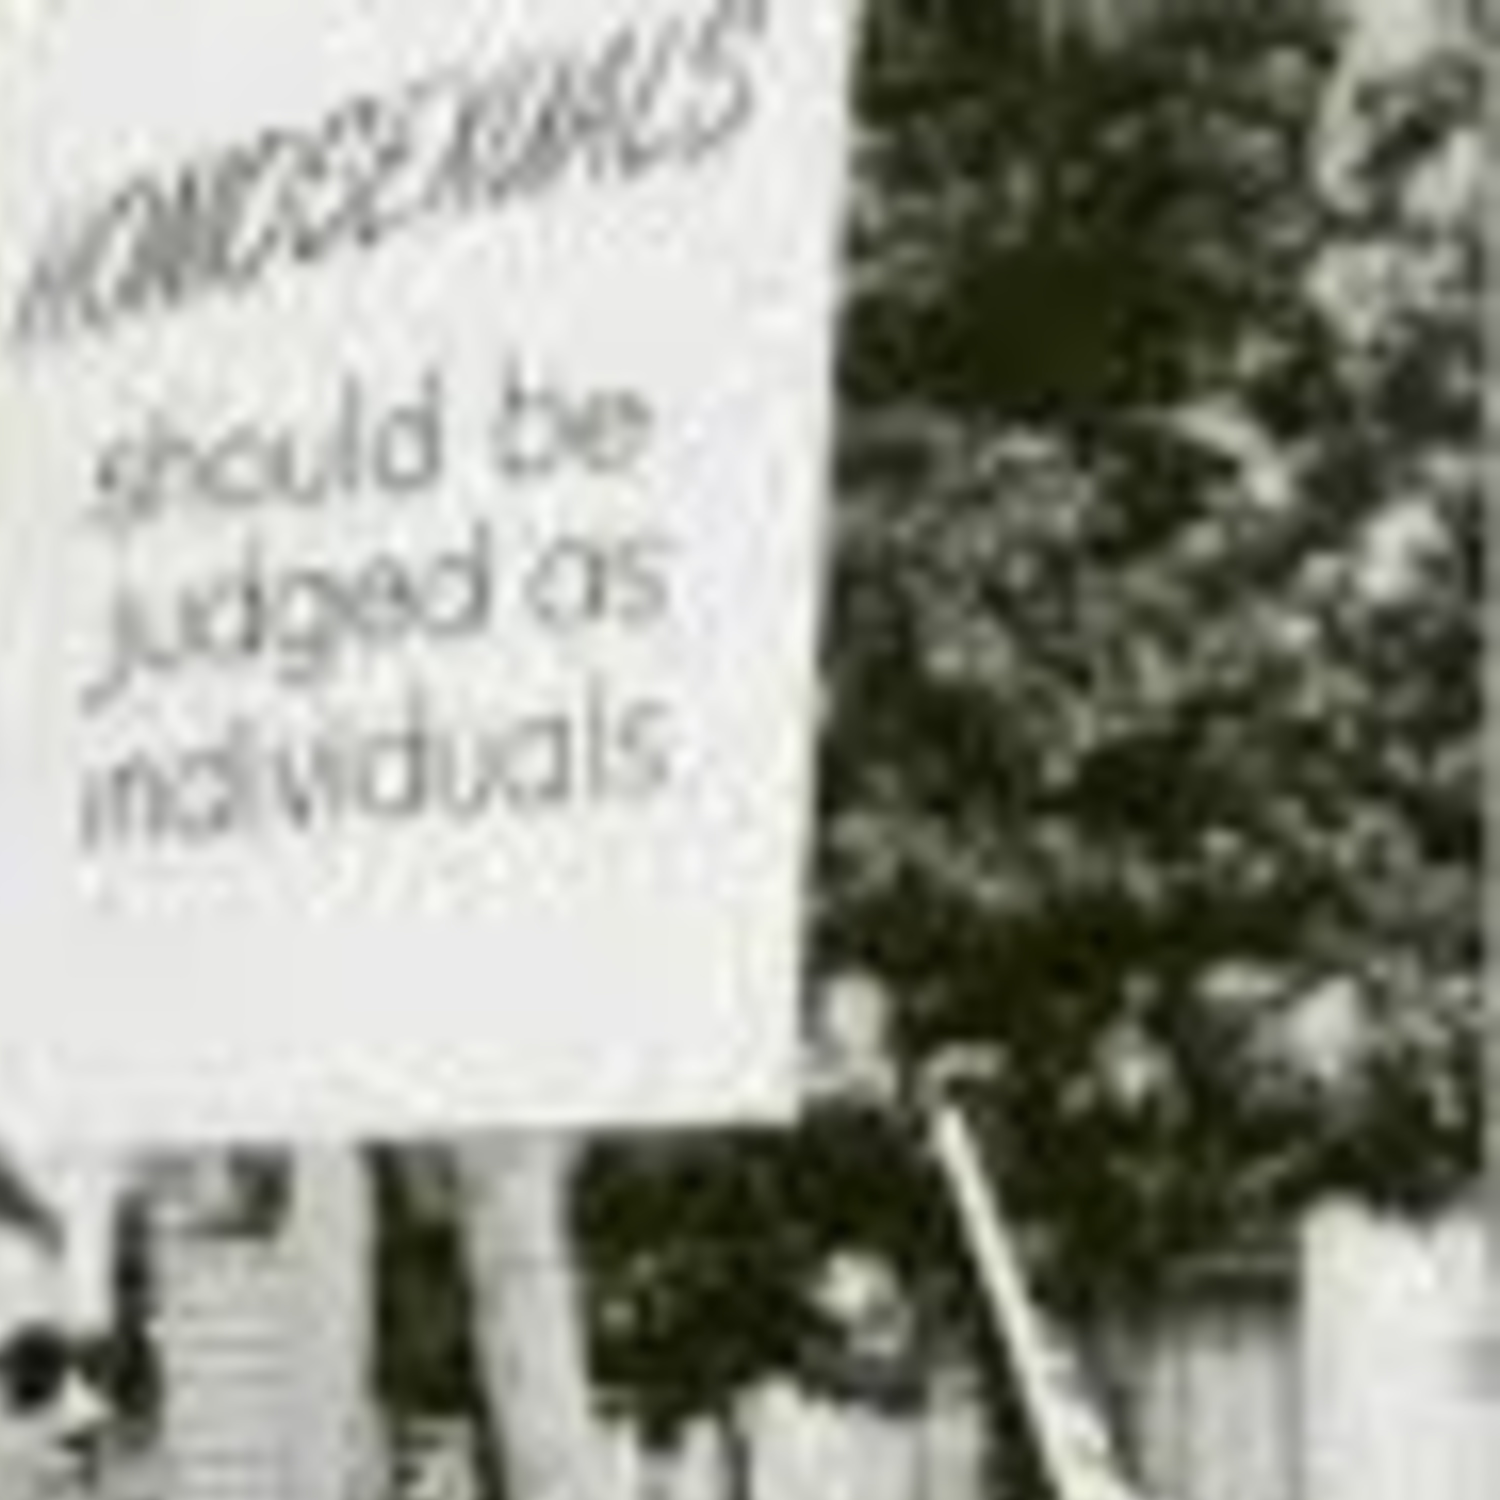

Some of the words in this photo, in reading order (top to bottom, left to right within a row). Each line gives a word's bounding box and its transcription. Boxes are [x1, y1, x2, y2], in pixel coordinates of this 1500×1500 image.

[93, 366, 442, 520] should
[490, 350, 653, 478] be
[78, 522, 493, 715] judged
[522, 534, 674, 634] as
[79, 672, 674, 852] individuals
